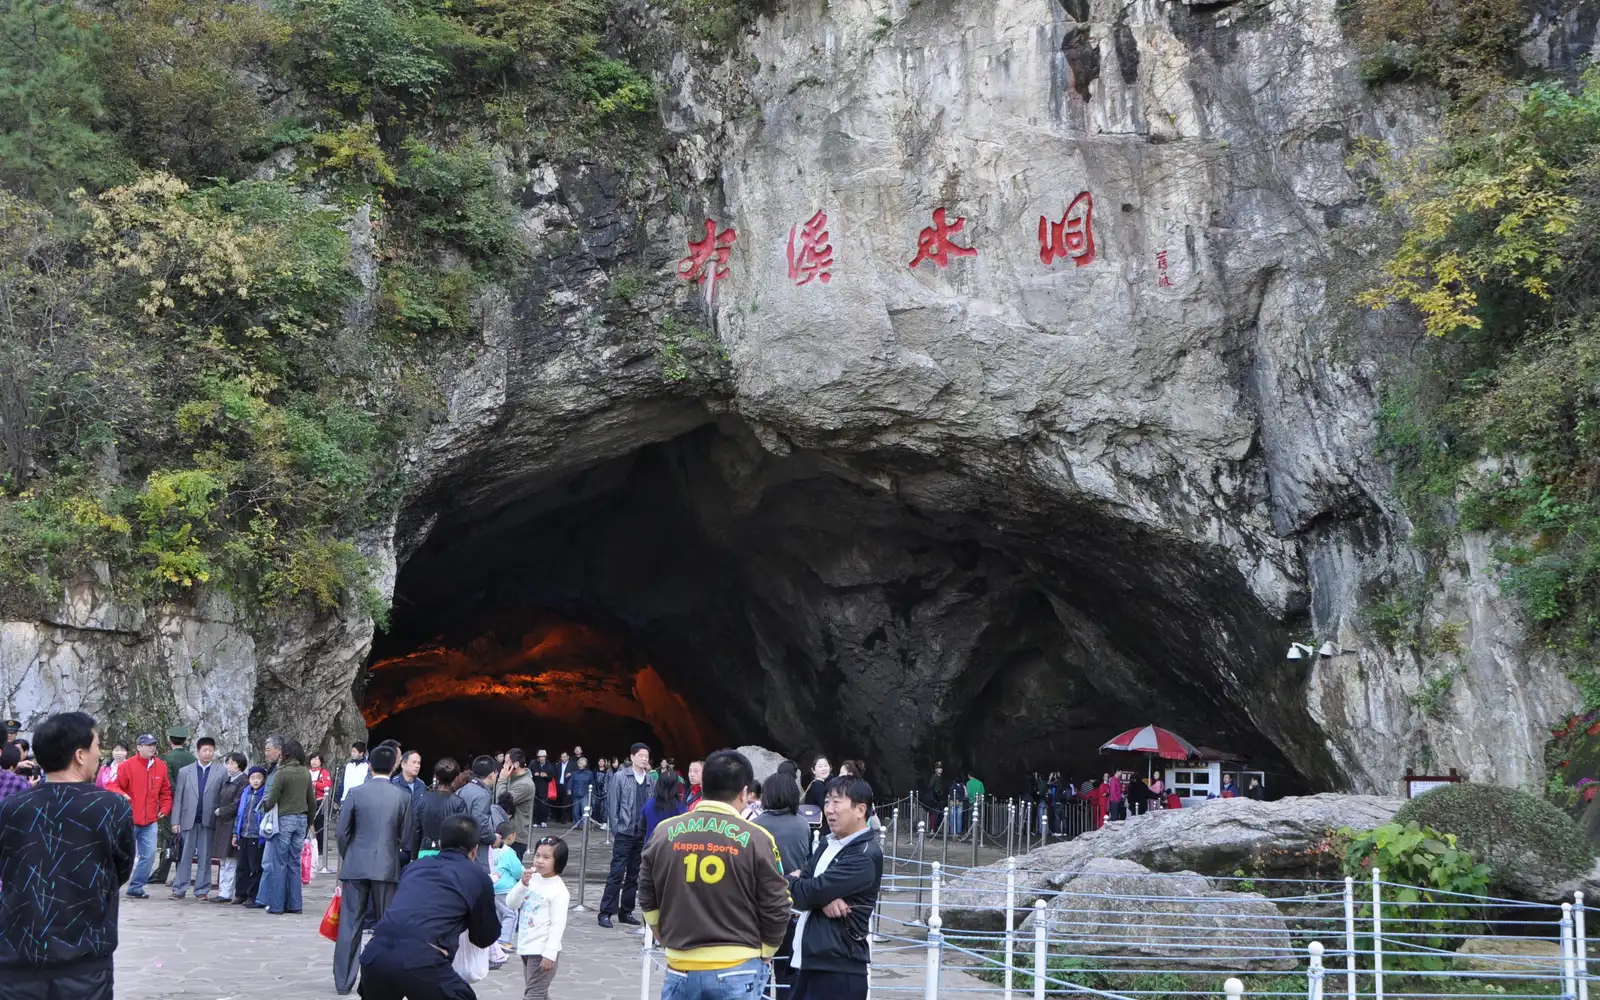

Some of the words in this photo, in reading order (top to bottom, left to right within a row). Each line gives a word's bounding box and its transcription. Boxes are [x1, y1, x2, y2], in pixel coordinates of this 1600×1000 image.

[668, 817, 750, 848] JAMAICA
[673, 842, 705, 852] Kappa
[706, 843, 739, 856] Sports
[683, 852, 726, 884] 10
